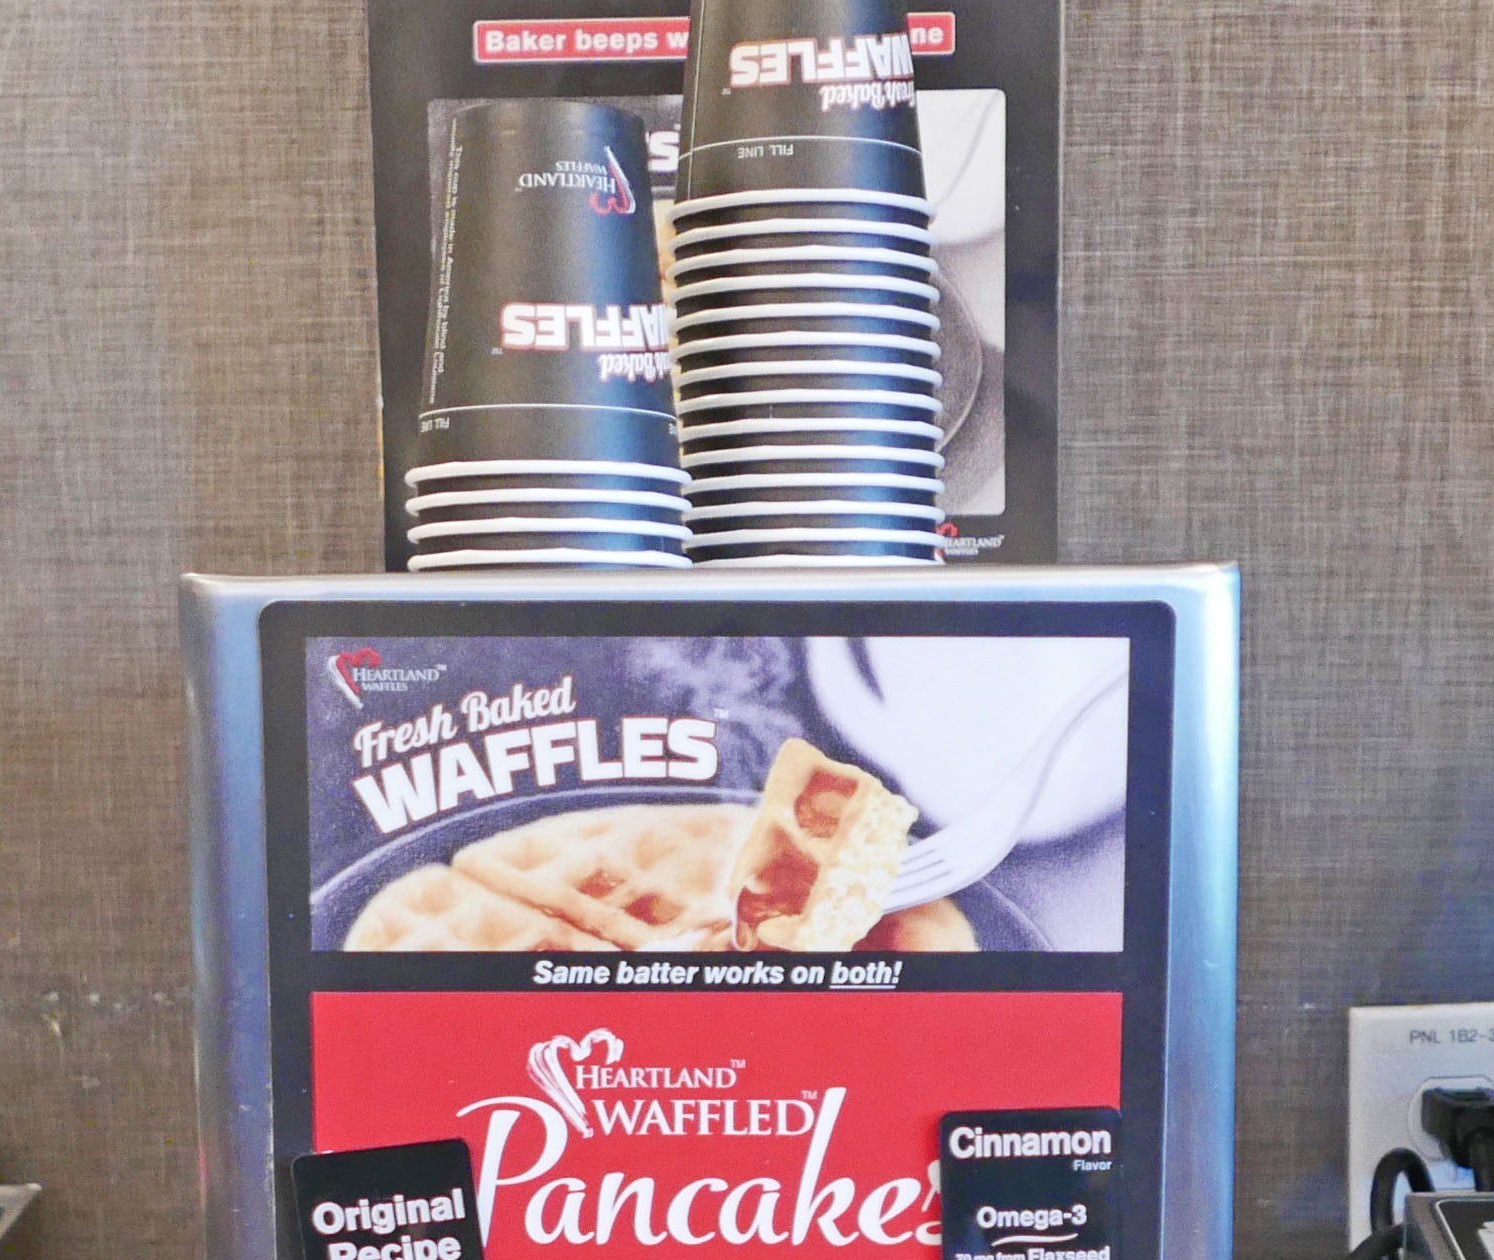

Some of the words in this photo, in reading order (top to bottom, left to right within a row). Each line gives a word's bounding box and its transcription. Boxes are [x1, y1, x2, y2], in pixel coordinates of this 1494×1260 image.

[485, 30, 566, 52] Baker
[575, 29, 658, 54] beeps
[909, 26, 944, 44] ne
[730, 33, 915, 87] WAFFLES
[820, 80, 884, 112] Baked
[737, 146, 764, 159] LINE
[769, 143, 794, 156] FILL
[555, 160, 608, 174] WAFFLES
[519, 172, 617, 194] HEARTLAND
[597, 353, 655, 383] Baked
[351, 667, 440, 682] HEARTLAND
[362, 682, 408, 692] WAFFLES
[353, 703, 459, 769] Fresh
[461, 675, 577, 733] Baked
[351, 716, 720, 835] WAFFLES
[532, 960, 611, 985] Same
[616, 961, 699, 985] batter
[704, 961, 785, 985] works
[791, 966, 825, 985] on
[829, 960, 903, 987] both!
[1410, 1029, 1441, 1044] PNL
[575, 1065, 737, 1089] HEARTLAND
[593, 1098, 815, 1137] WAFFLED
[949, 1126, 1112, 1159] Cinnamon
[1072, 1159, 1113, 1171] Flavor
[312, 1187, 466, 1235] Original
[976, 1204, 1087, 1230] Omega-3
